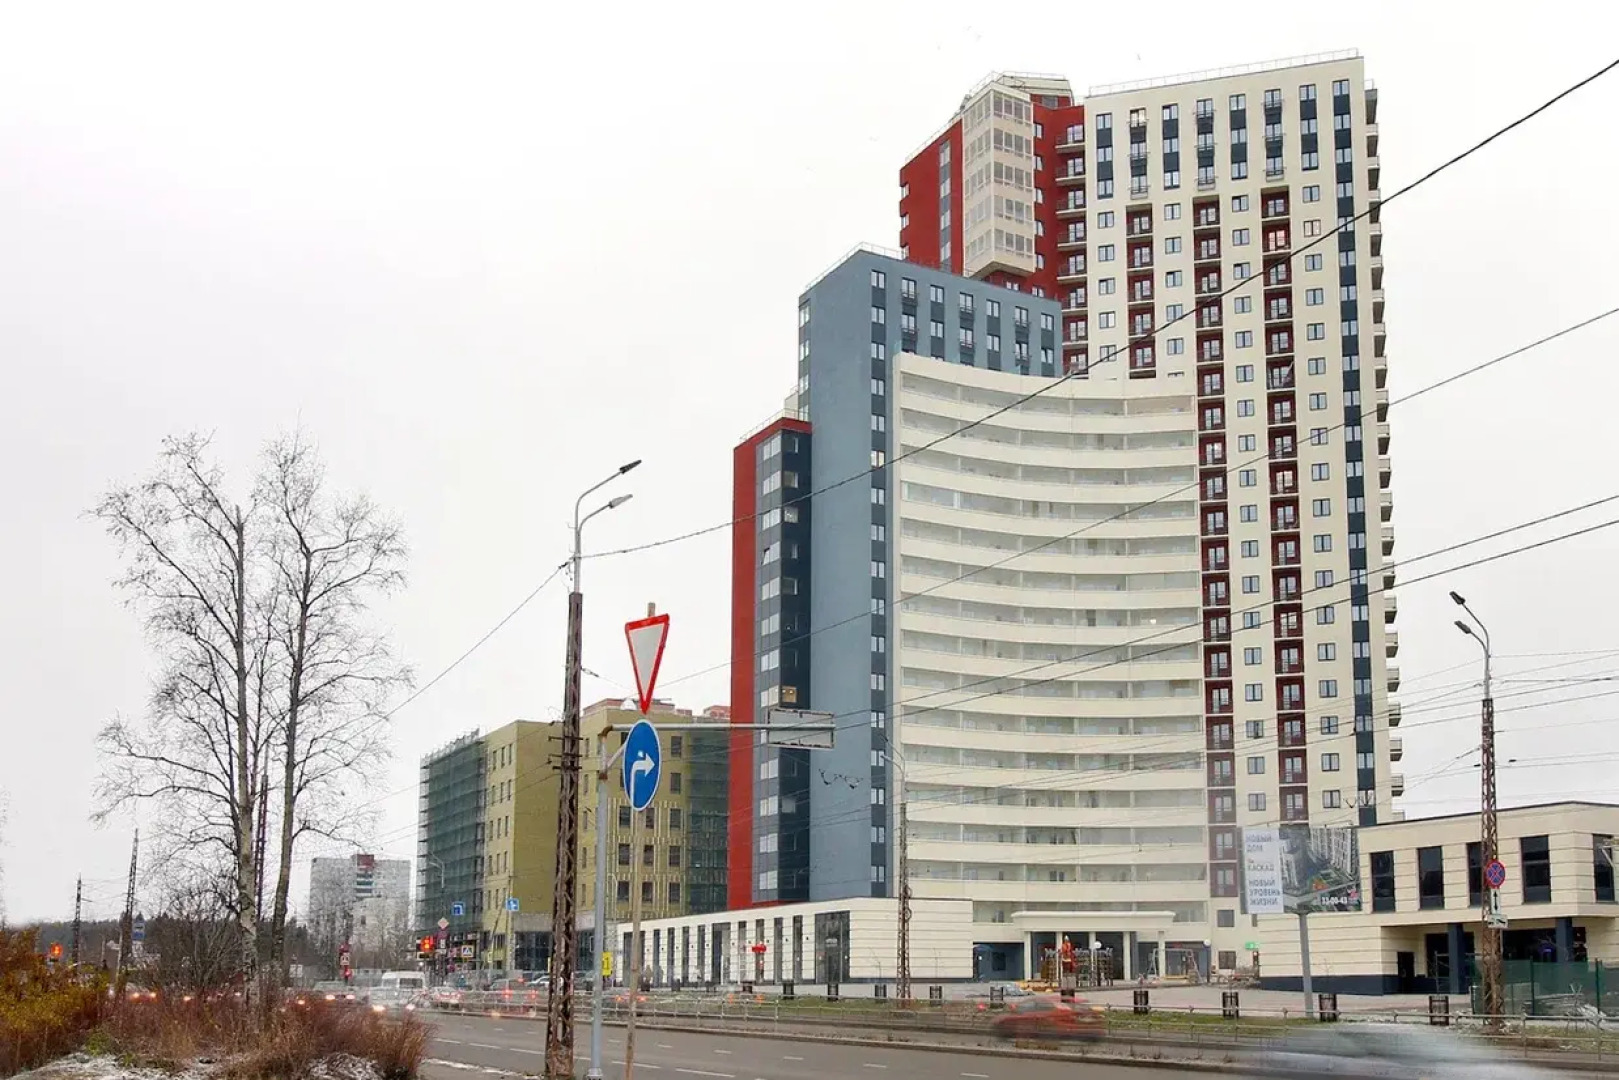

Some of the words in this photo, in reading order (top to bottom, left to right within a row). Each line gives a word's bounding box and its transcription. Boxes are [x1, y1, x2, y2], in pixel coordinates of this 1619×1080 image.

[1246, 833, 1272, 842] НОВЫЙ
[1249, 878, 1276, 887] НОВЫЙ
[1249, 888, 1281, 896] УРОВЕНЬ
[1249, 897, 1279, 906] ЖИЗНИ
